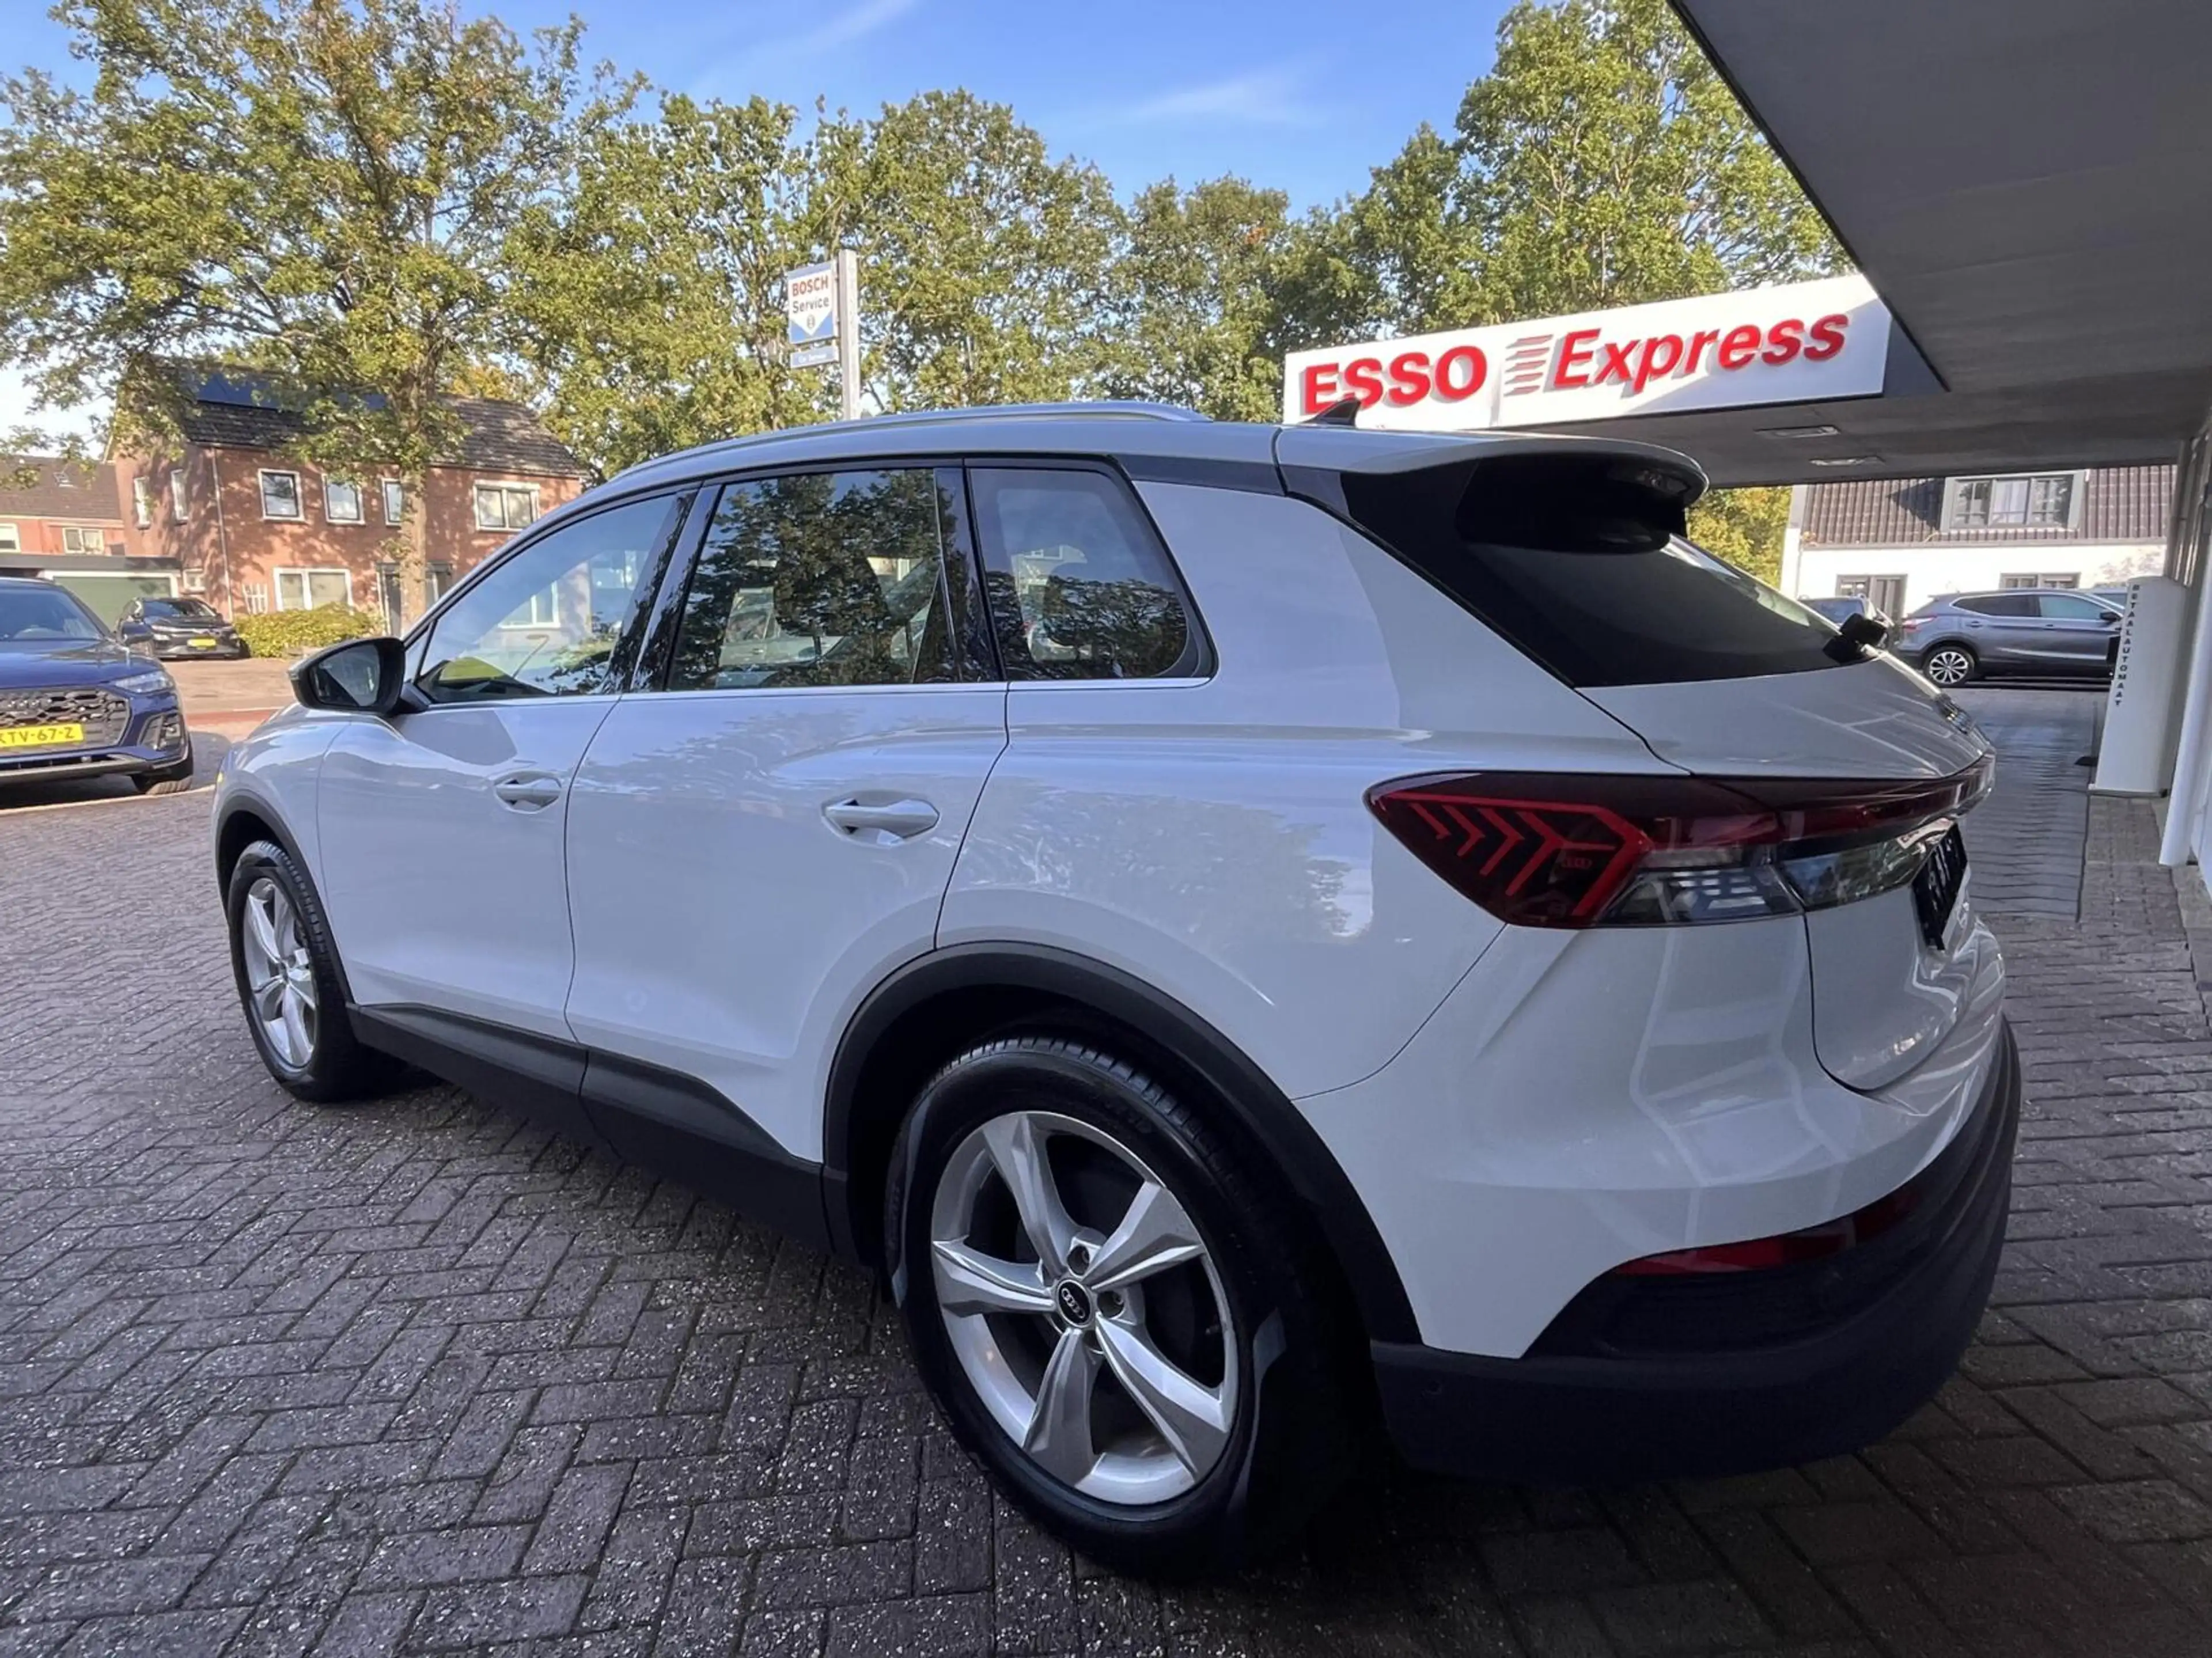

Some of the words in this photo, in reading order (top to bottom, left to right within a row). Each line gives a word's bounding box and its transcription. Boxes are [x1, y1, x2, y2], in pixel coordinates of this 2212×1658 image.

[792, 276, 828, 297] BOSCH
[793, 297, 829, 313] Service
[1304, 346, 1487, 415] ESSO
[1554, 314, 1849, 393] Express
